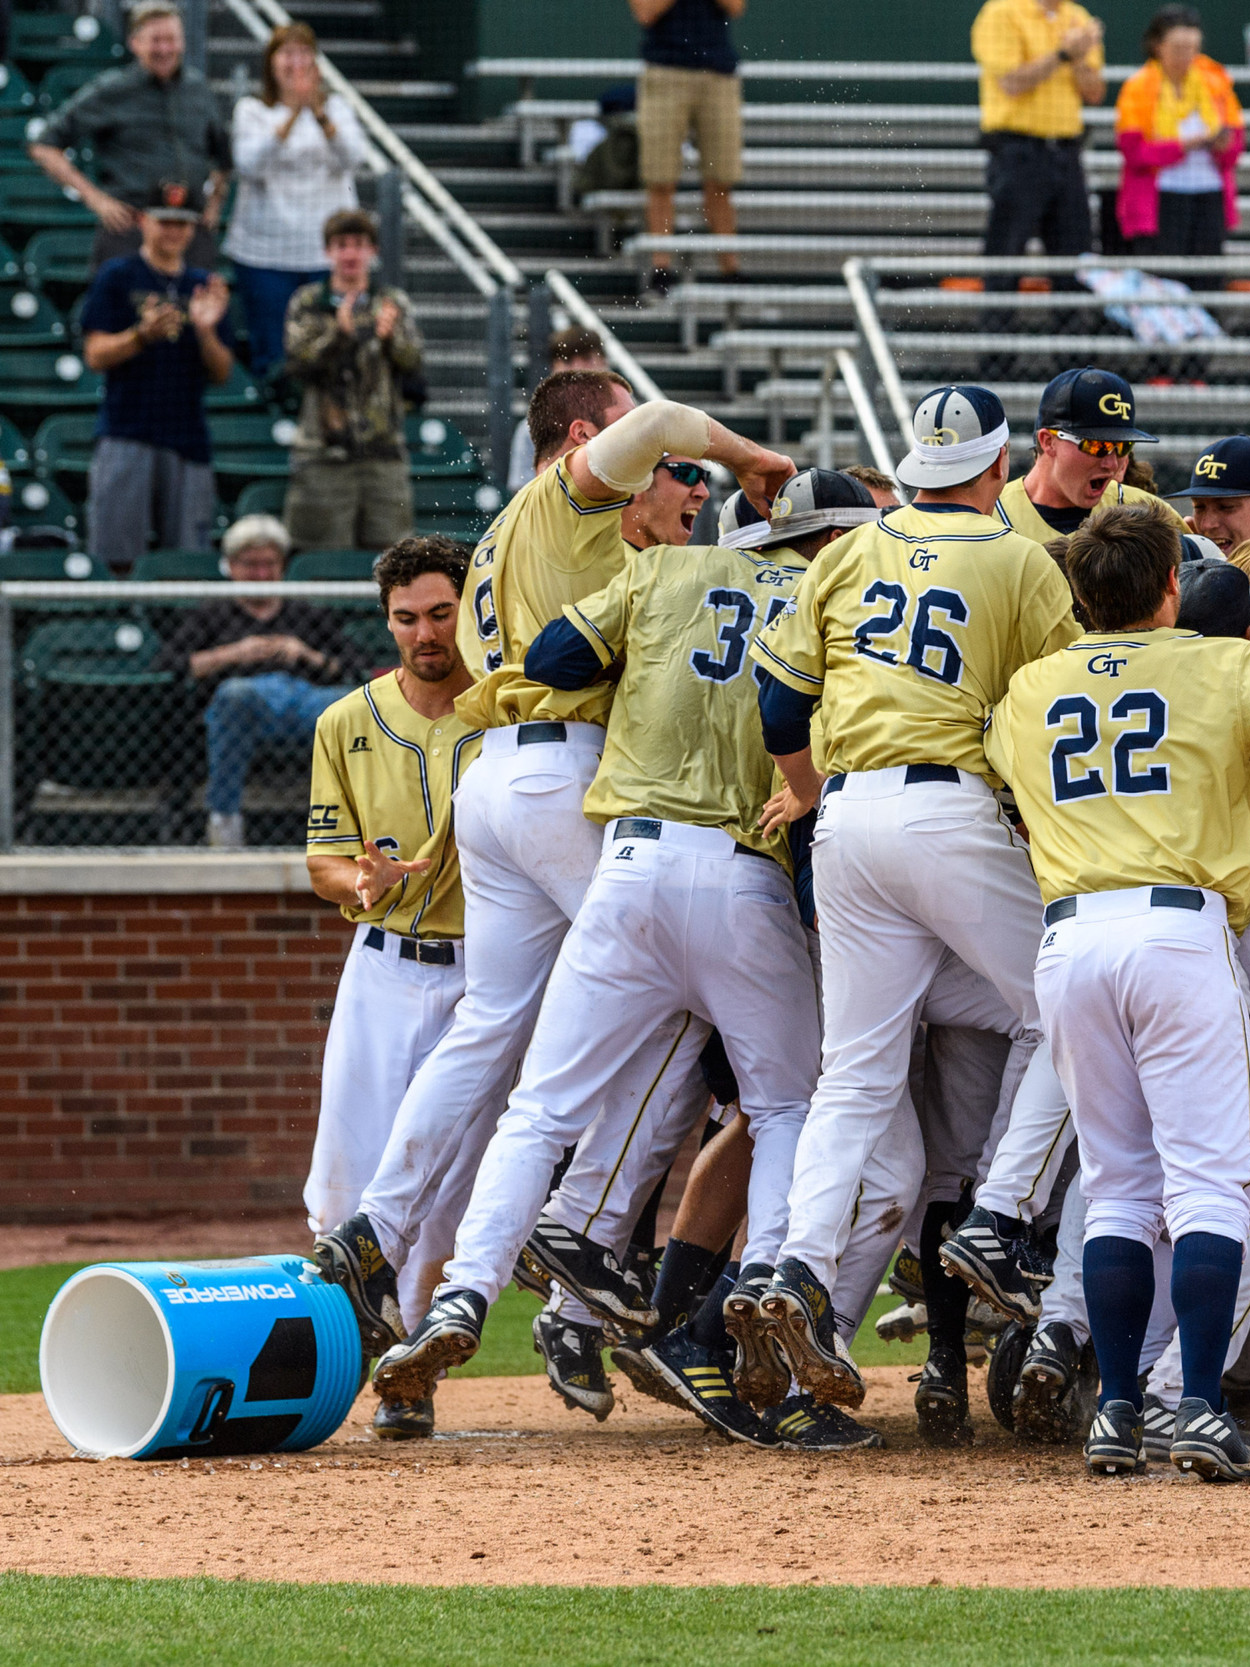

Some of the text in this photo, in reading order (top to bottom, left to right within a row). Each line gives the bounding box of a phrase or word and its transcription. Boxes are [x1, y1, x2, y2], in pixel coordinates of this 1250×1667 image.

[1098, 392, 1132, 421] GT
[1194, 453, 1228, 479] GT
[909, 548, 939, 571] GT
[755, 569, 794, 587] GT
[851, 577, 972, 687] 26
[1087, 652, 1128, 678] GT
[1044, 688, 1172, 807] 22
[161, 1283, 297, 1305] POWERADE
